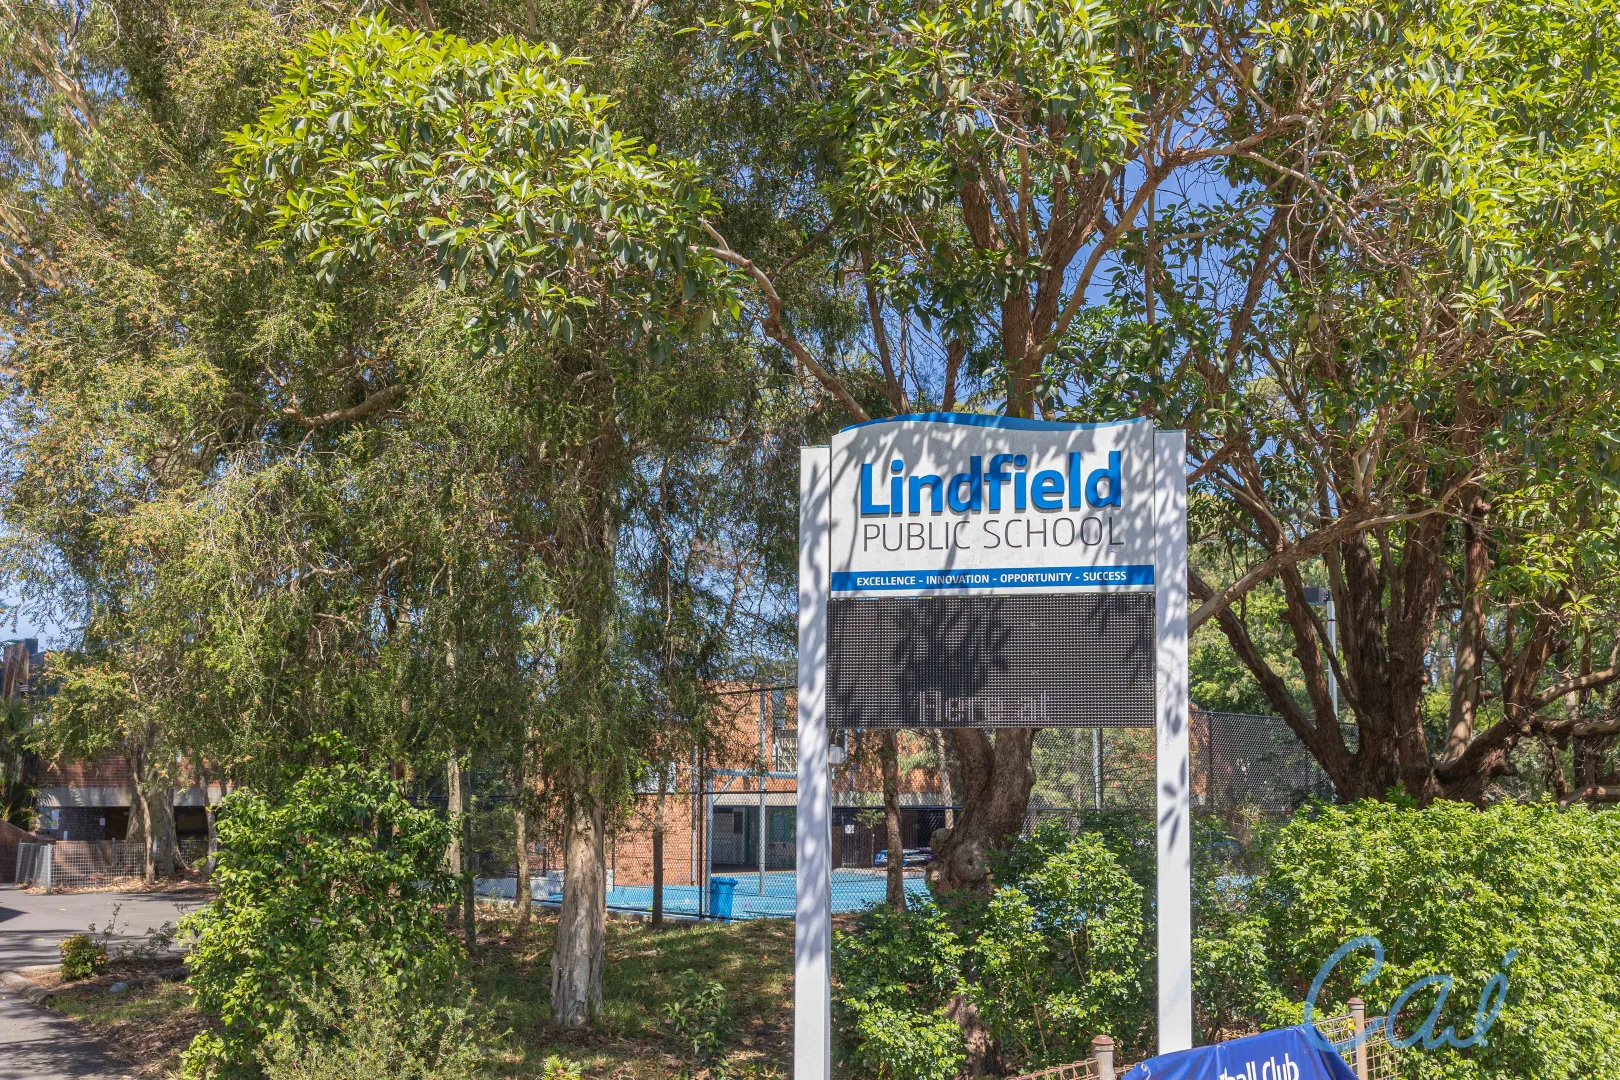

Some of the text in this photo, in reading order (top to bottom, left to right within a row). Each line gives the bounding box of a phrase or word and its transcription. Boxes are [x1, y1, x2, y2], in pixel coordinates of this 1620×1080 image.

[860, 450, 1122, 517] Lindfield
[863, 516, 1125, 552] PUBLIC SCHOOL
[856, 576, 916, 586] EXCELLENCE
[926, 574, 990, 585] INNOVATION
[1000, 572, 1073, 583] OPPORTUNITY
[1082, 571, 1127, 582] SUCCESS
[918, 690, 1004, 722] Here
[1262, 1052, 1300, 1080] club
